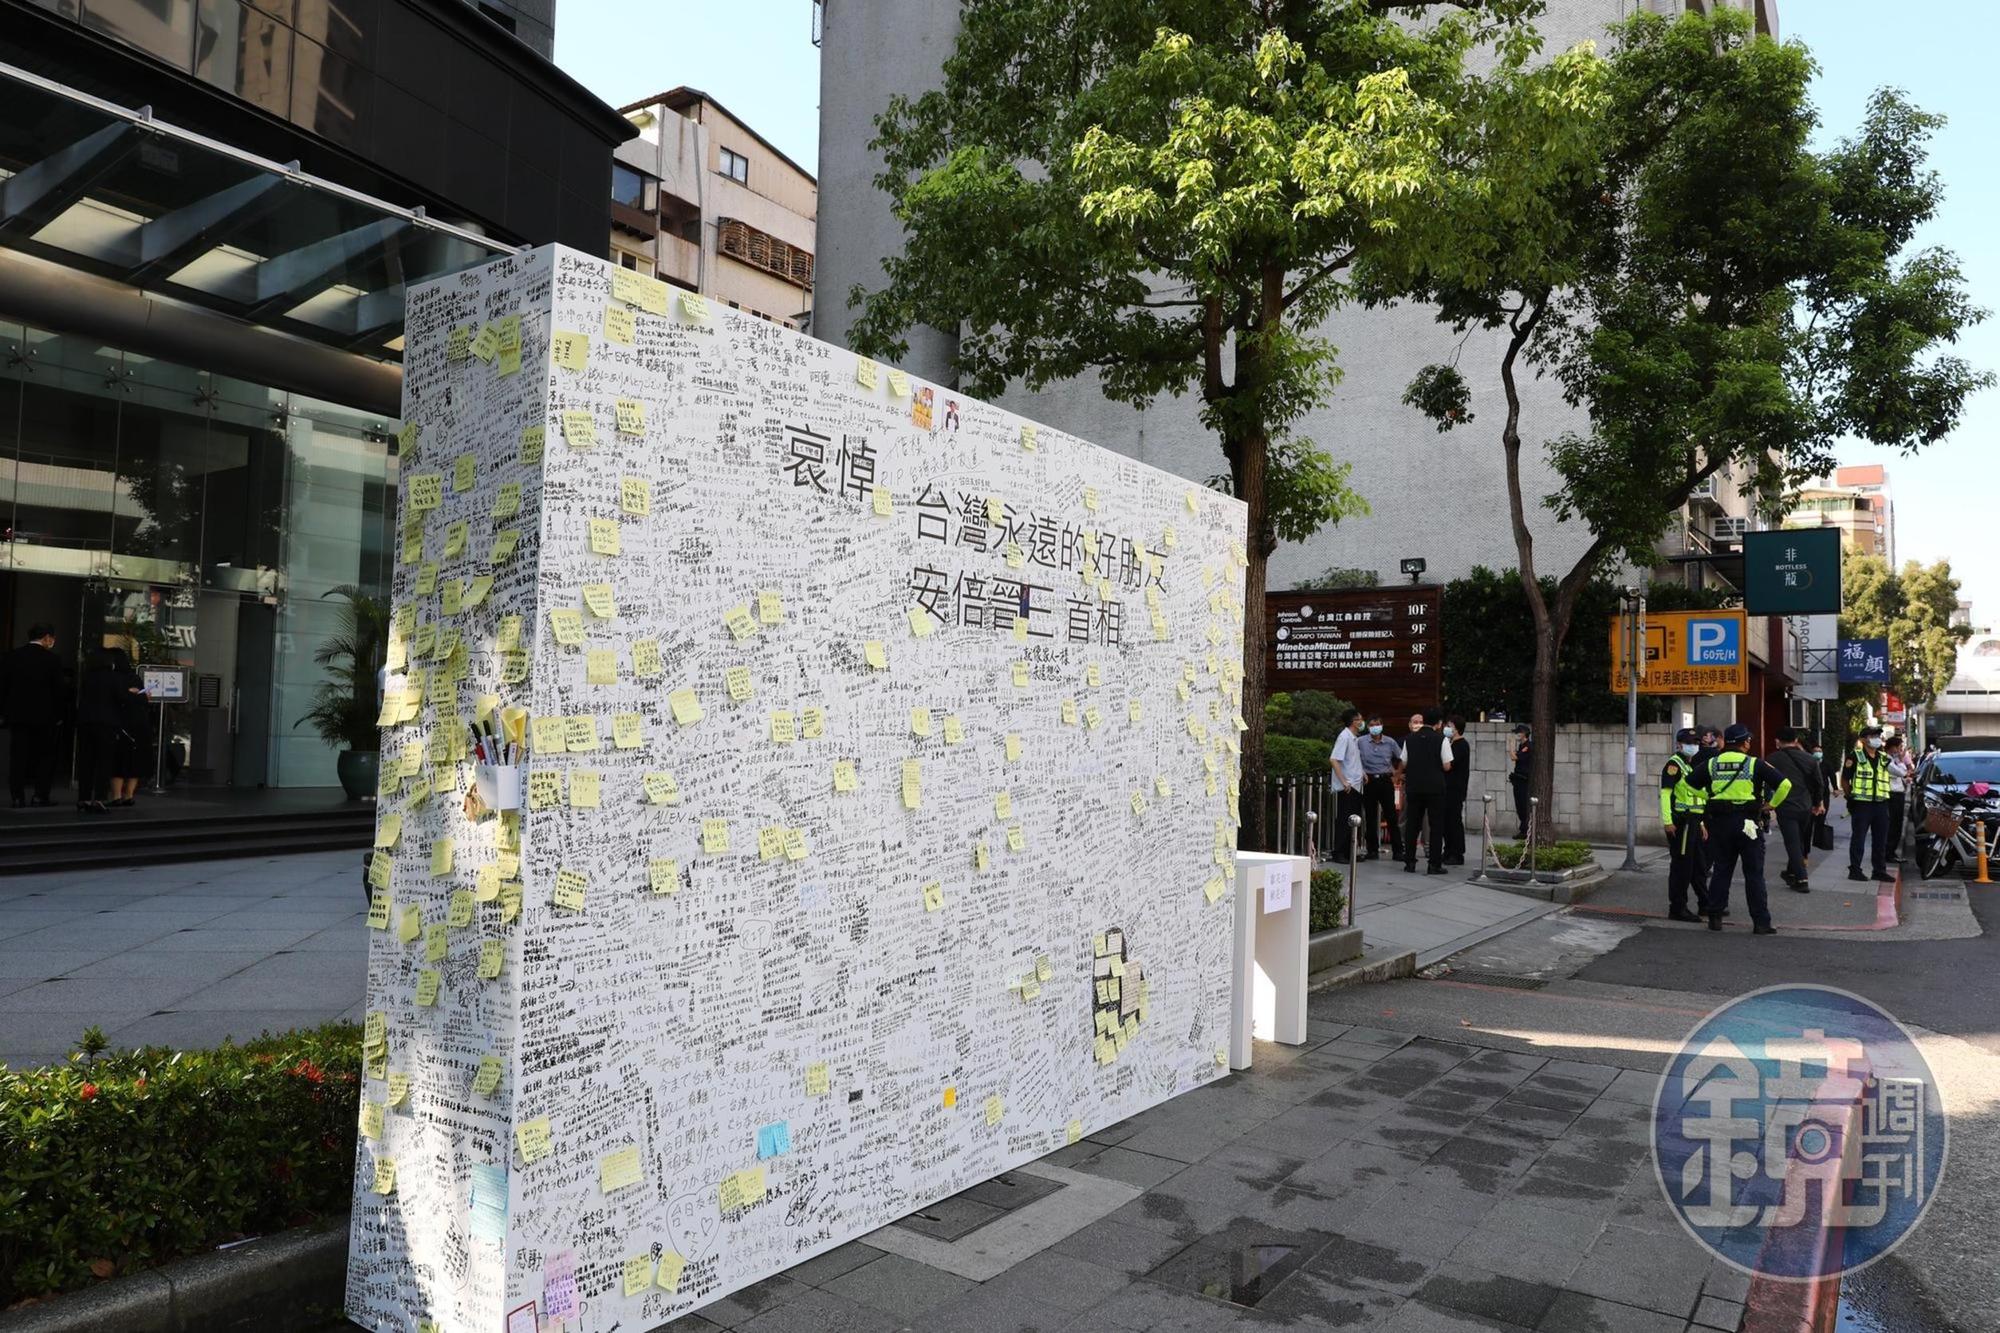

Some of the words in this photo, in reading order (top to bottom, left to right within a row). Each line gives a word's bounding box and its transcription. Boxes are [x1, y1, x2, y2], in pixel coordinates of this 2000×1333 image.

[783, 423, 877, 501] 哀悼
[917, 483, 1168, 593] 台灣永遠的好朋友
[1784, 548, 1798, 561] 非
[912, 564, 1122, 647] 安倍晉三首相
[1408, 604, 1428, 616] 10F
[1411, 624, 1427, 634] 9F
[1276, 642, 1351, 651] MinebeaMitsumi
[1692, 622, 1726, 661] P
[1411, 643, 1427, 654] 8F
[1703, 649, 1736, 661] 60元/H
[1339, 660, 1393, 669] MANAGEMENT
[1411, 663, 1427, 674] 7F
